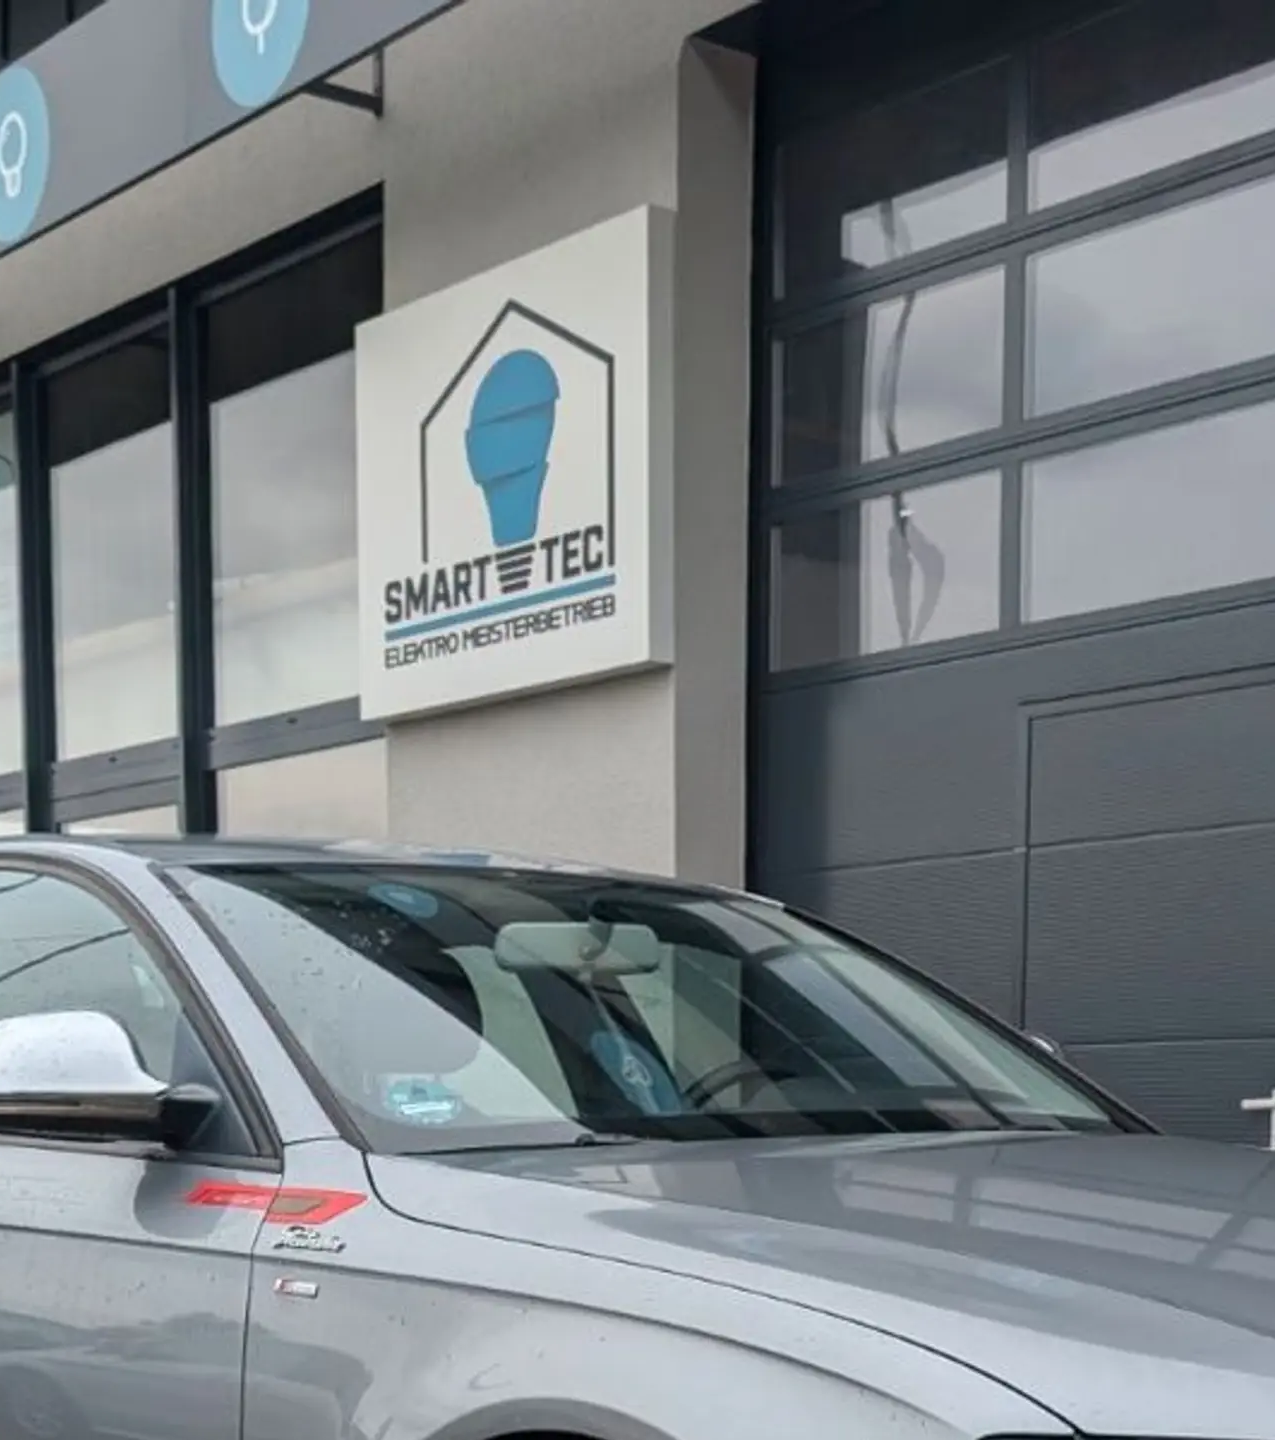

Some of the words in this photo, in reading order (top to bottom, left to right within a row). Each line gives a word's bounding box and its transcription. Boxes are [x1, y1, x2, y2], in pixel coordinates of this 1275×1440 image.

[384, 555, 493, 624] SMART
[539, 524, 604, 583] TEC
[384, 633, 458, 669] ELEKTRO
[462, 594, 616, 651] MEISTERBETRIEB
